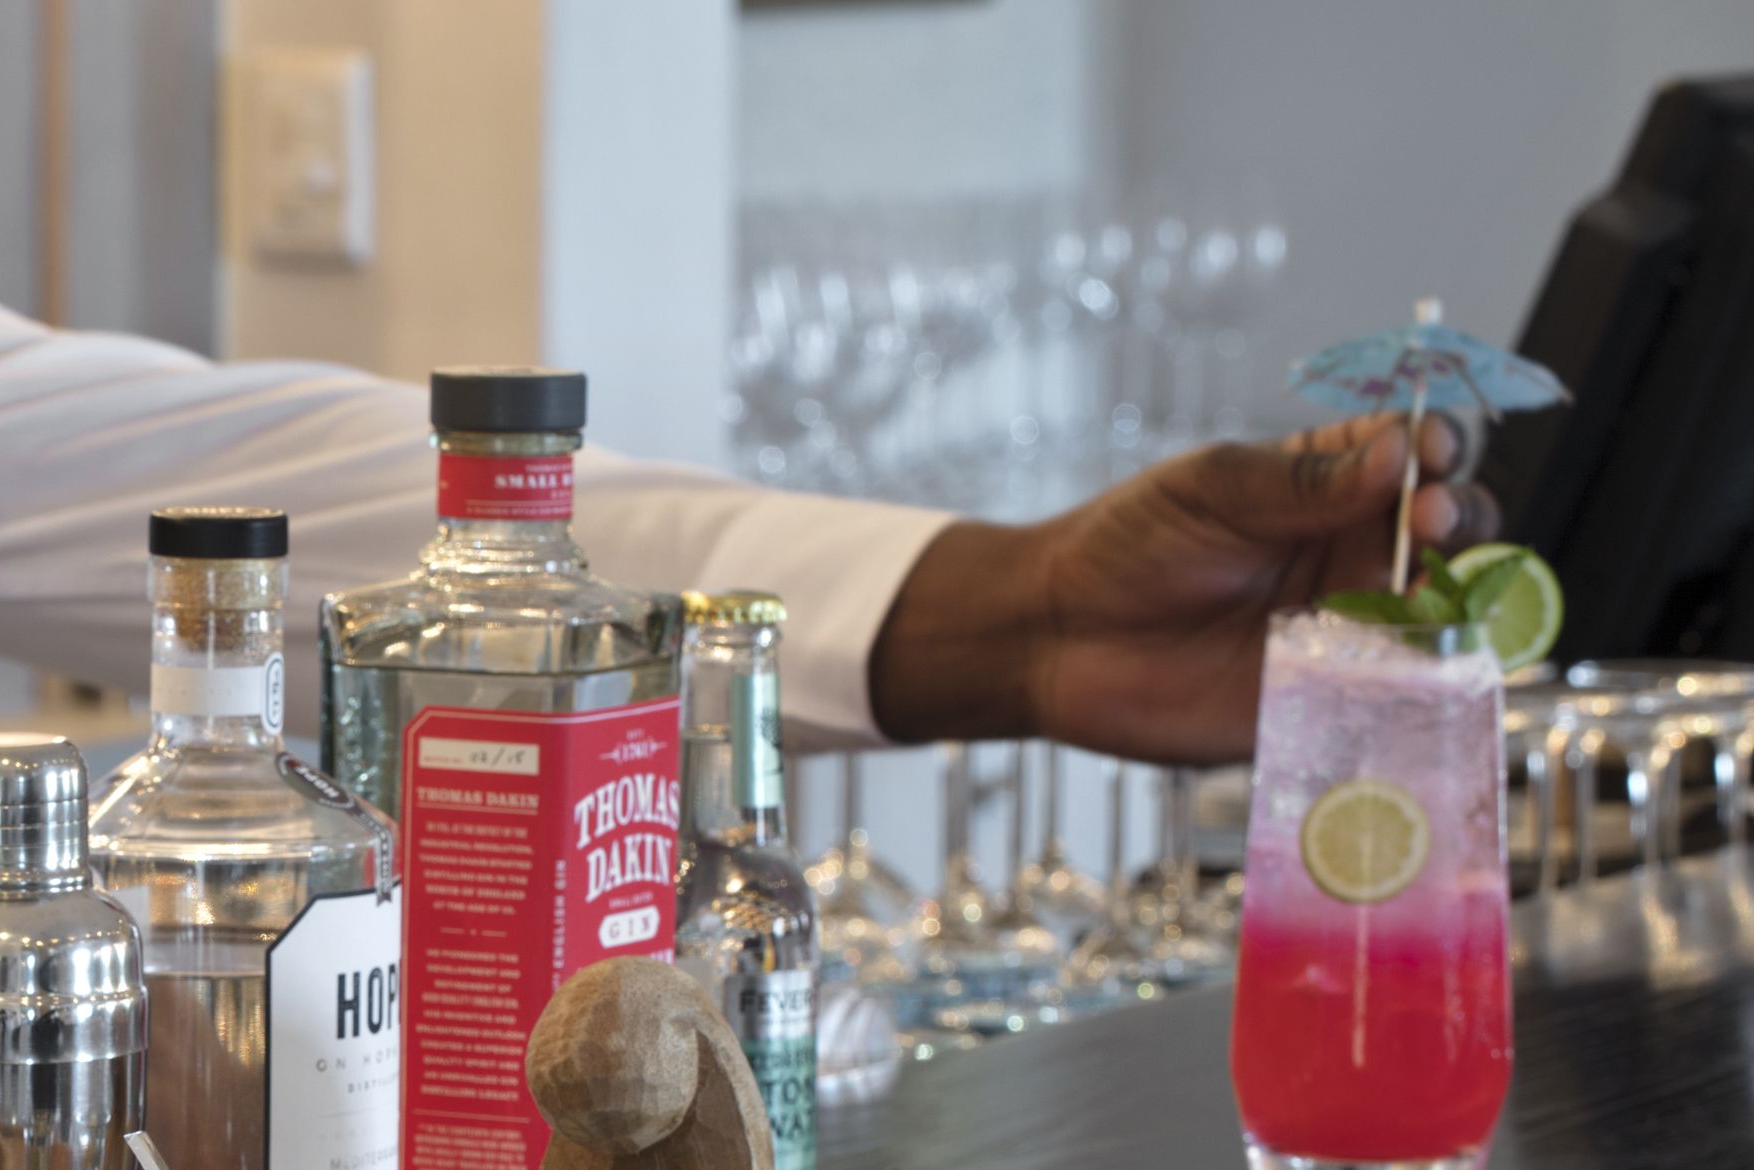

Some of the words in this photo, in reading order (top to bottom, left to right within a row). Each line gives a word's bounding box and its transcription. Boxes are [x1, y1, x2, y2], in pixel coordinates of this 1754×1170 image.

[417, 786, 482, 805] THOMAS
[486, 791, 539, 809] DAKIN
[574, 773, 680, 849] THOMAS
[586, 833, 672, 902] DAKIN
[609, 915, 651, 939] GIN
